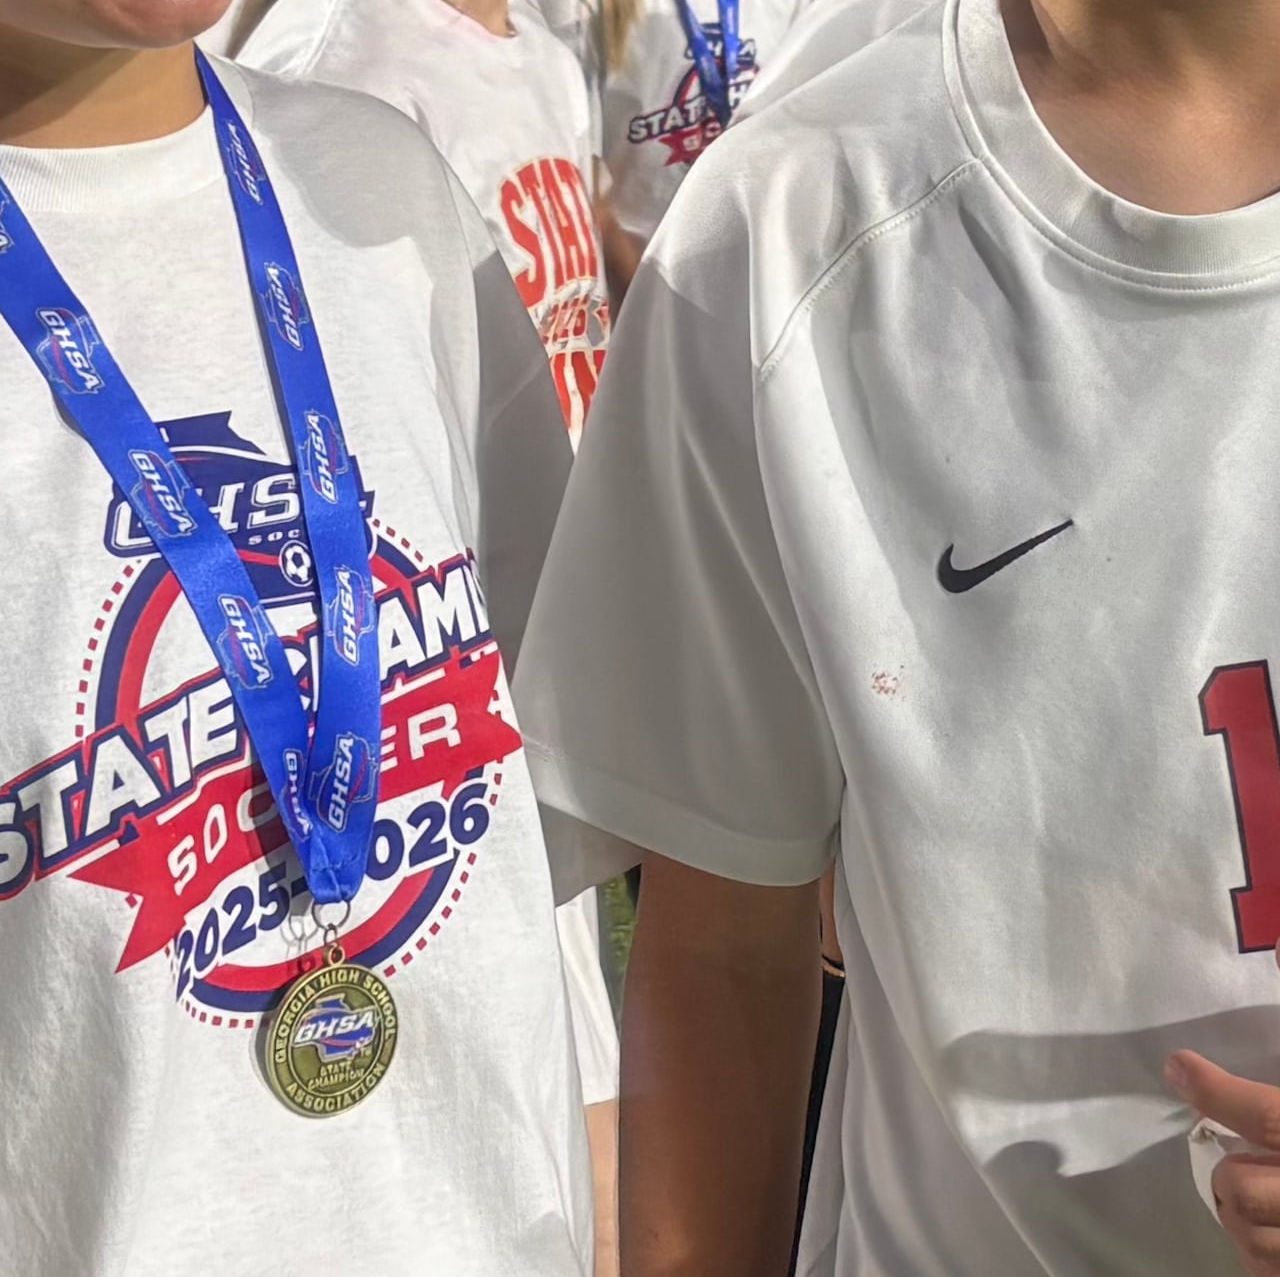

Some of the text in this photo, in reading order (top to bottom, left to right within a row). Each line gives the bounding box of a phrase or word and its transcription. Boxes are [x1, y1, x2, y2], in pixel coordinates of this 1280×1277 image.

[628, 97, 708, 143] STAT
[268, 266, 301, 349] GHSA
[40, 310, 100, 392] GHSA
[131, 451, 195, 533] GHSA
[308, 412, 337, 501] GHSA
[248, 528, 301, 545] SOC
[220, 597, 271, 685] GHSA
[332, 566, 358, 662] GHSA
[167, 703, 462, 896] SOCER
[328, 734, 354, 830] GHSA
[175, 784, 490, 1004] 2025-026
[275, 968, 397, 1063] GEORGIA HIGH SCHOOL
[294, 1008, 375, 1043] GHSA
[286, 1063, 386, 1112] ASSOCIATION
